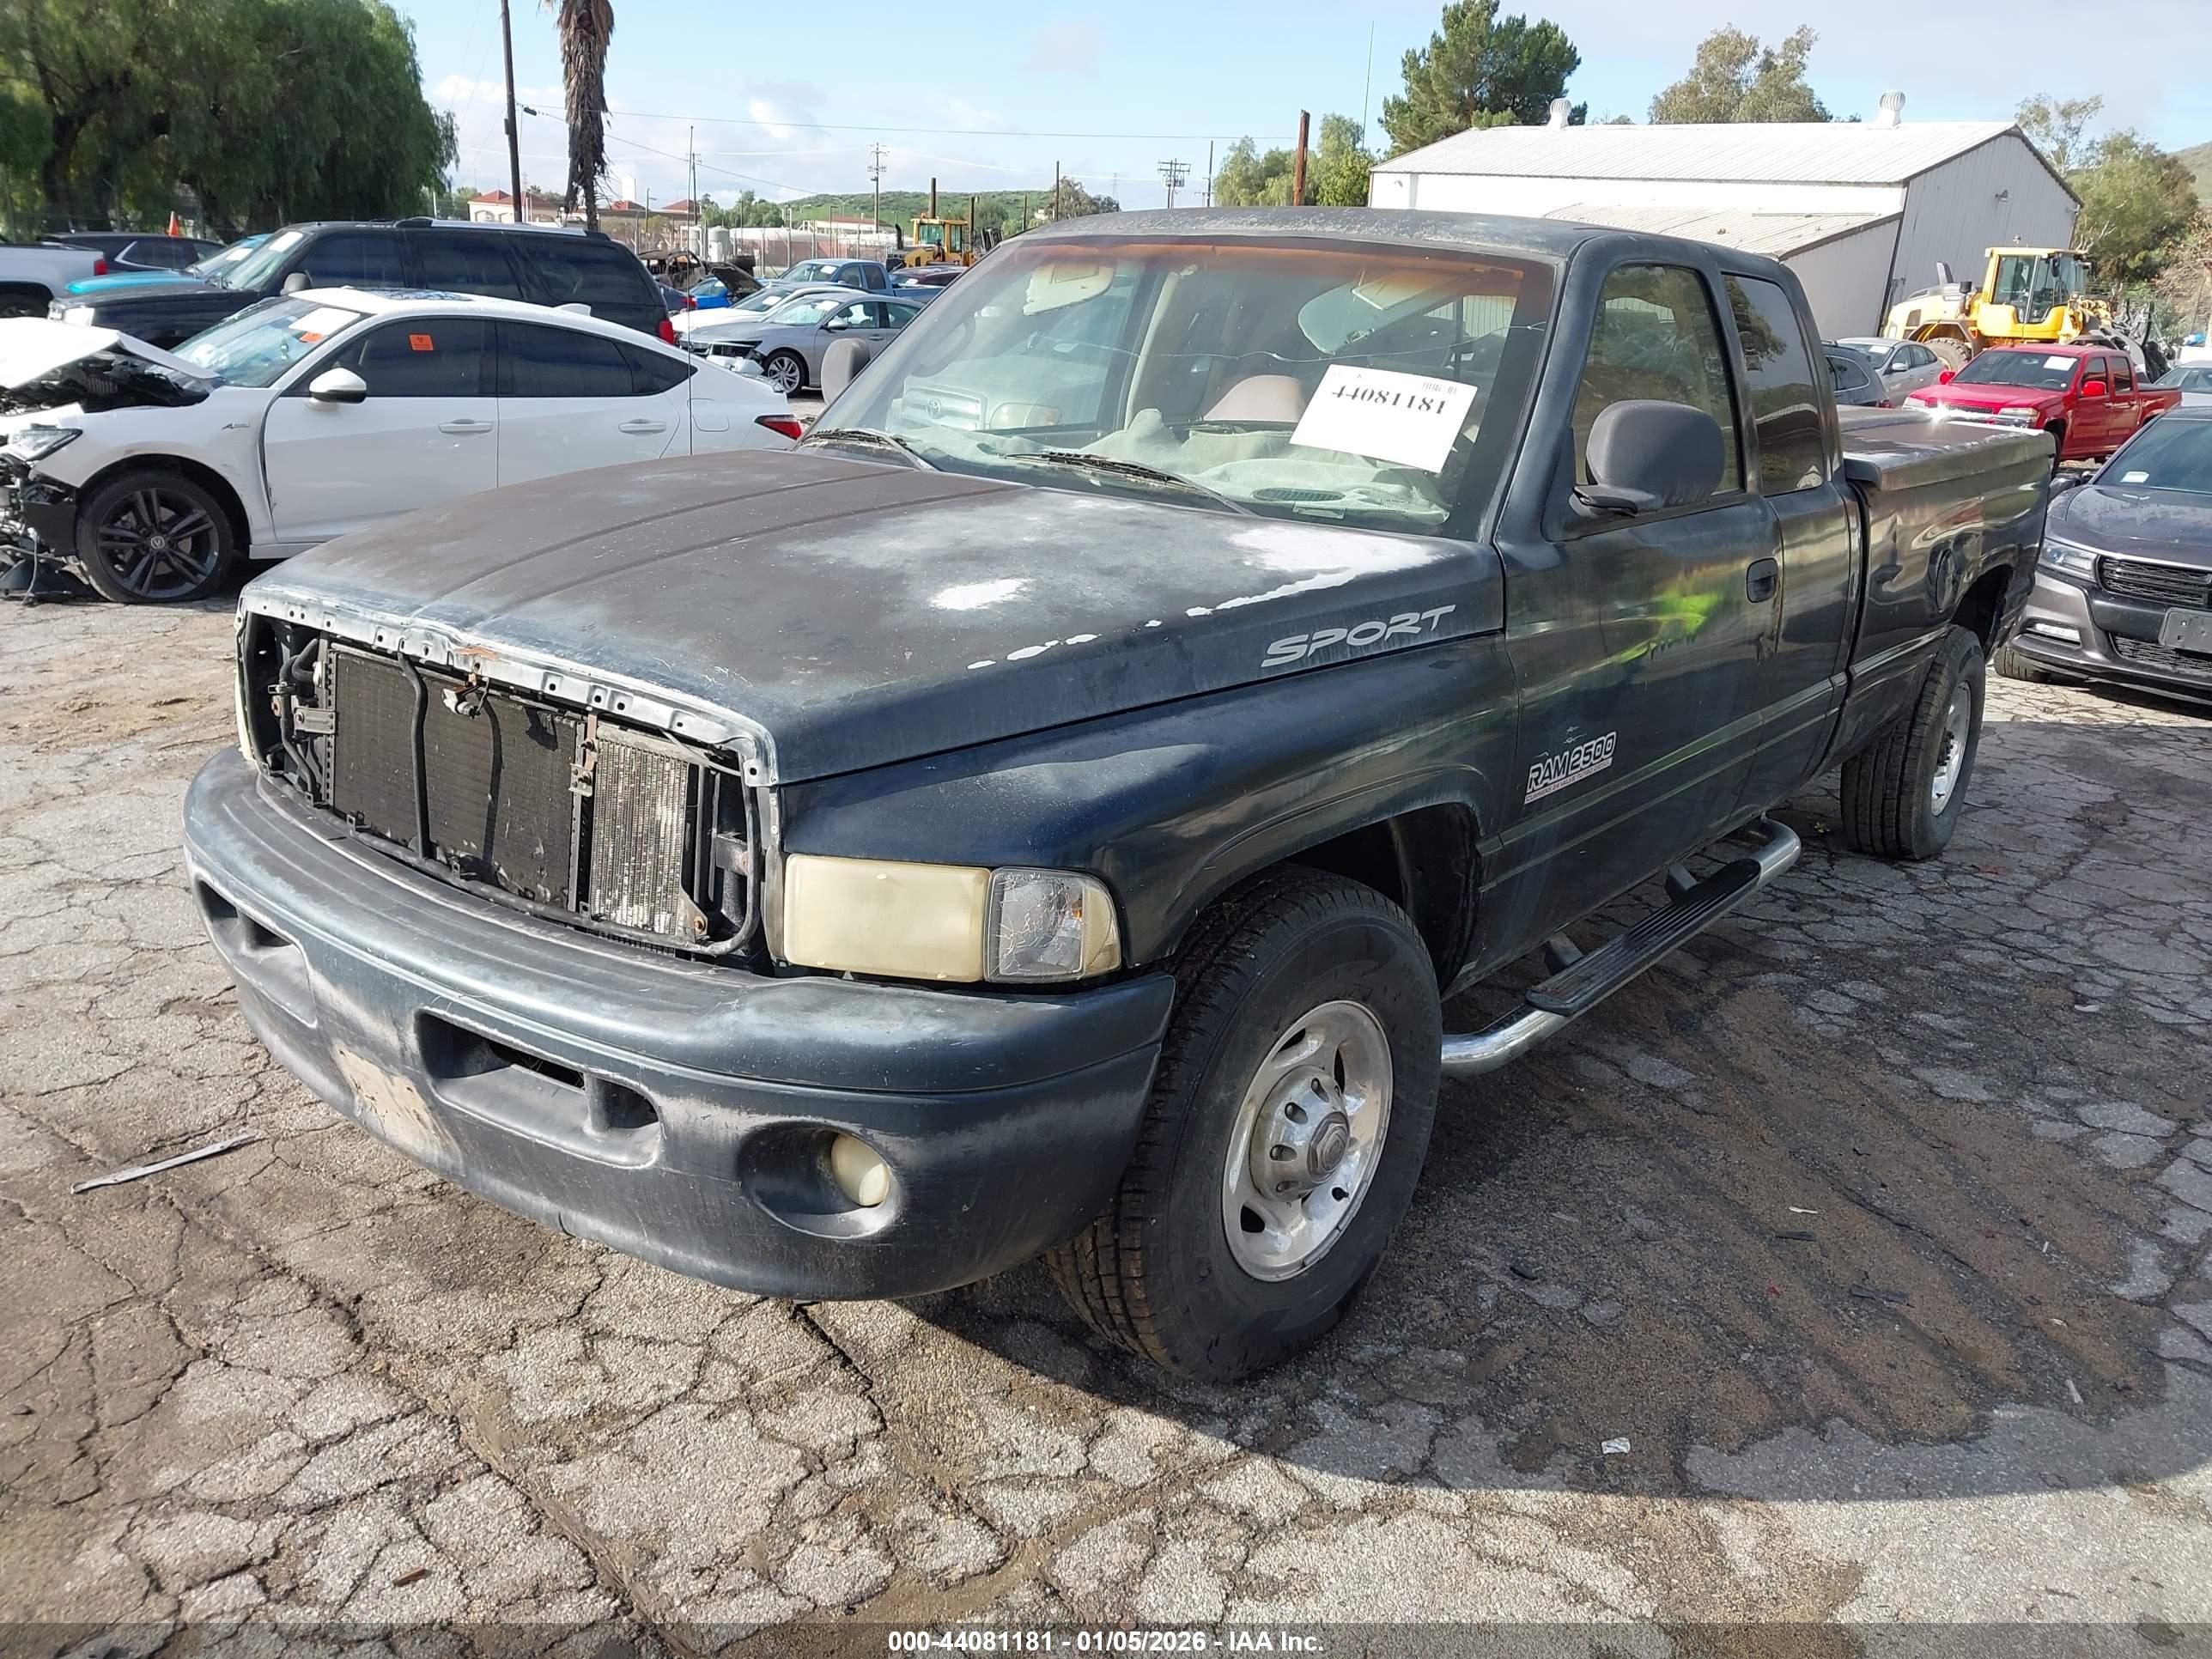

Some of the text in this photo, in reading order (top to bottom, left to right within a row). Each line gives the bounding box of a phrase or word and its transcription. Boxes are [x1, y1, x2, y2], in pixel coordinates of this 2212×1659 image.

[1332, 385, 1446, 415] 44081181
[1261, 604, 1457, 668] SPORT
[1526, 731, 1617, 793] RAM 2500
